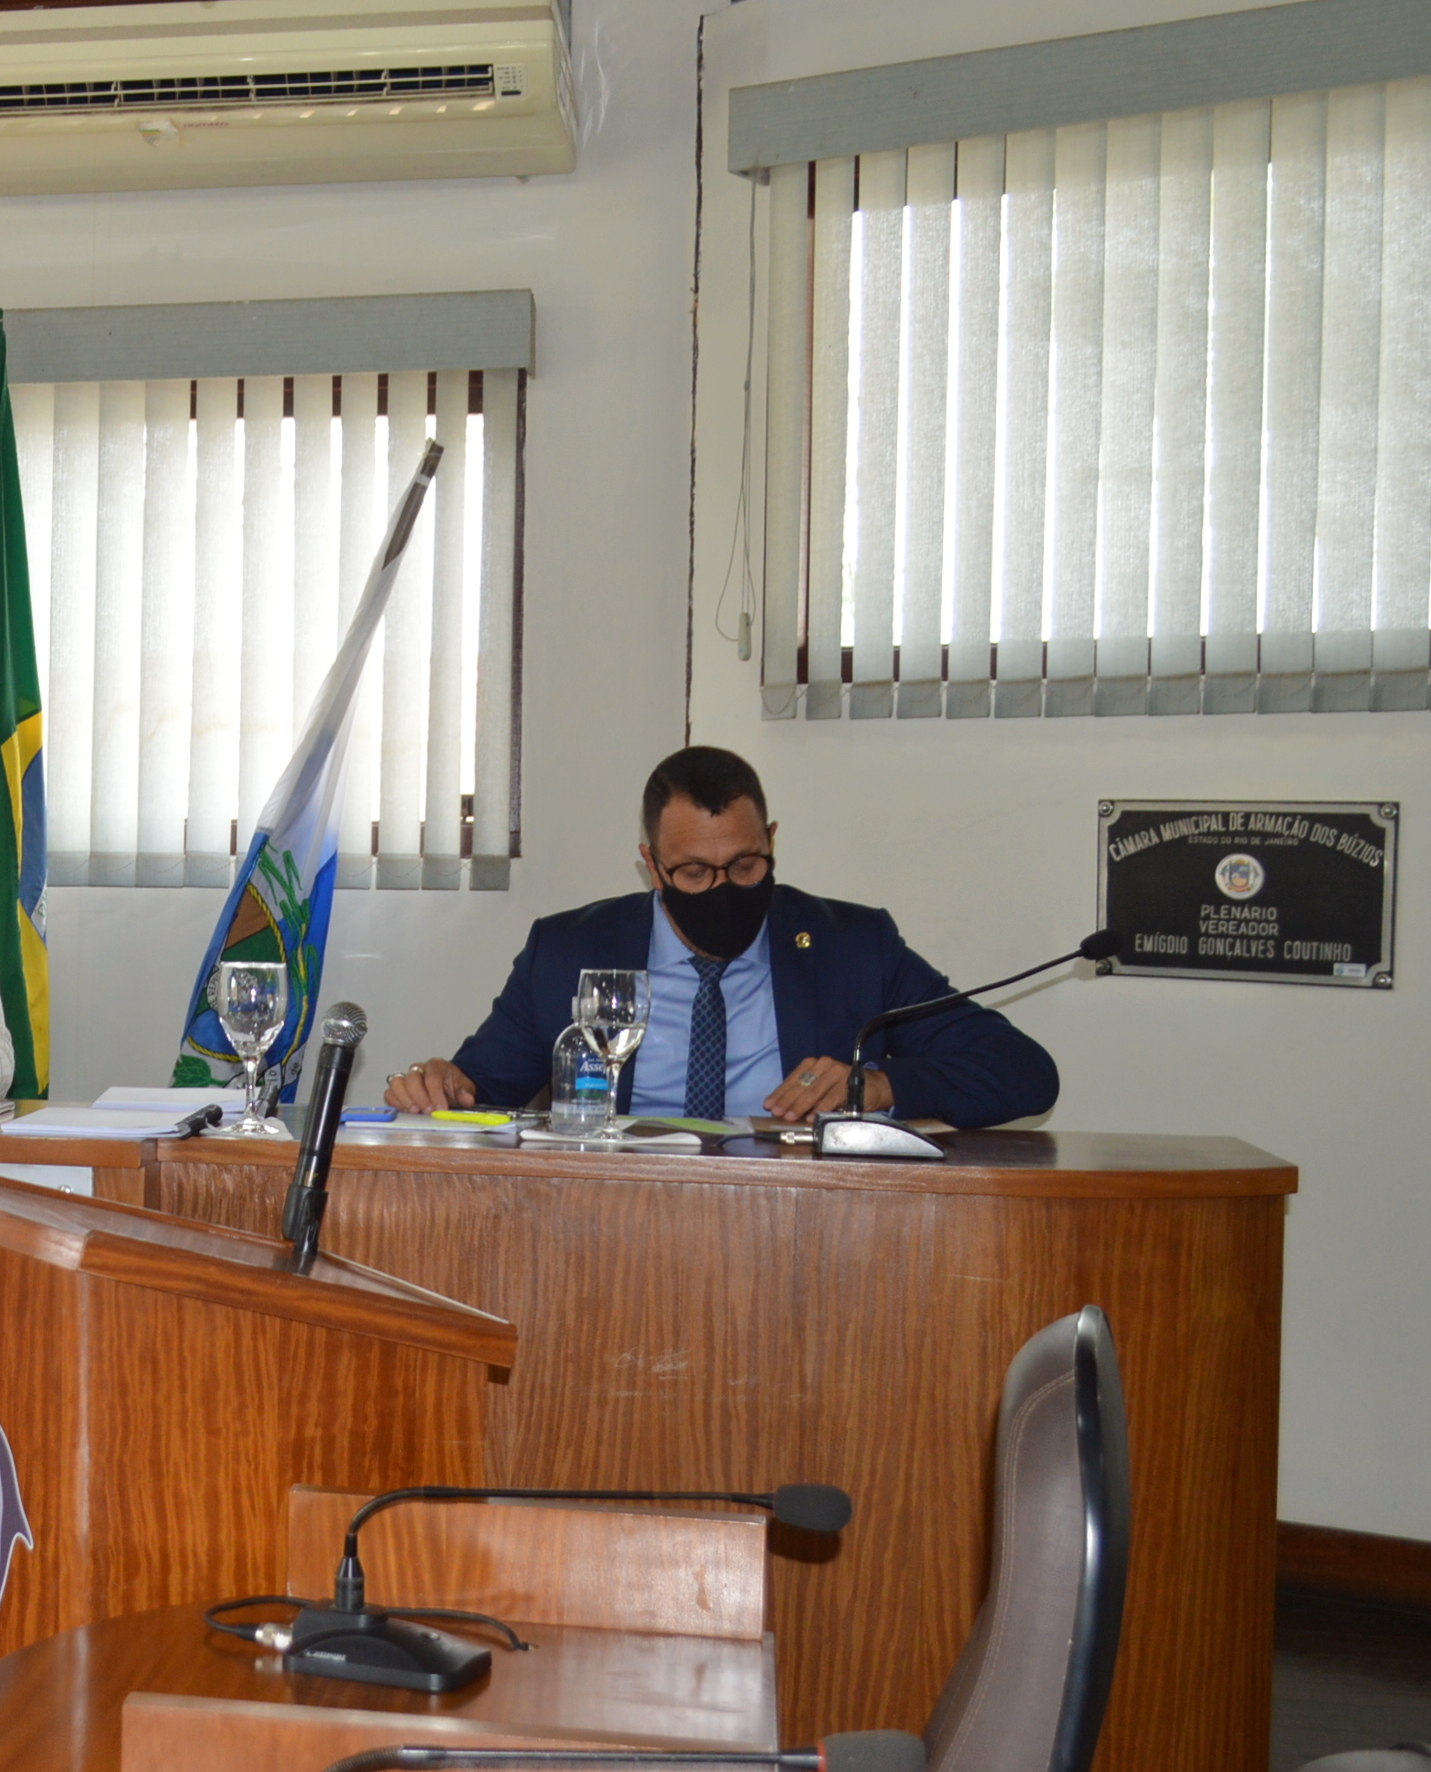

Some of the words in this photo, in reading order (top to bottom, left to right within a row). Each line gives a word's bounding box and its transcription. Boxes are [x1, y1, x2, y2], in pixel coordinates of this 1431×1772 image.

[1159, 813, 1226, 842] MUNICIPAL
[1229, 812, 1245, 831] DE
[1248, 813, 1309, 839] ARMAÇÃO
[1309, 823, 1338, 848] DOS
[1336, 833, 1383, 867] BÚZIOS
[1201, 904, 1277, 921] PLENÁRIO
[1199, 920, 1279, 936] VEREADOR
[1135, 932, 1188, 954] EMÍGDIO
[1198, 936, 1275, 959] GONÇALVES
[1284, 941, 1352, 962] COUTINHO
